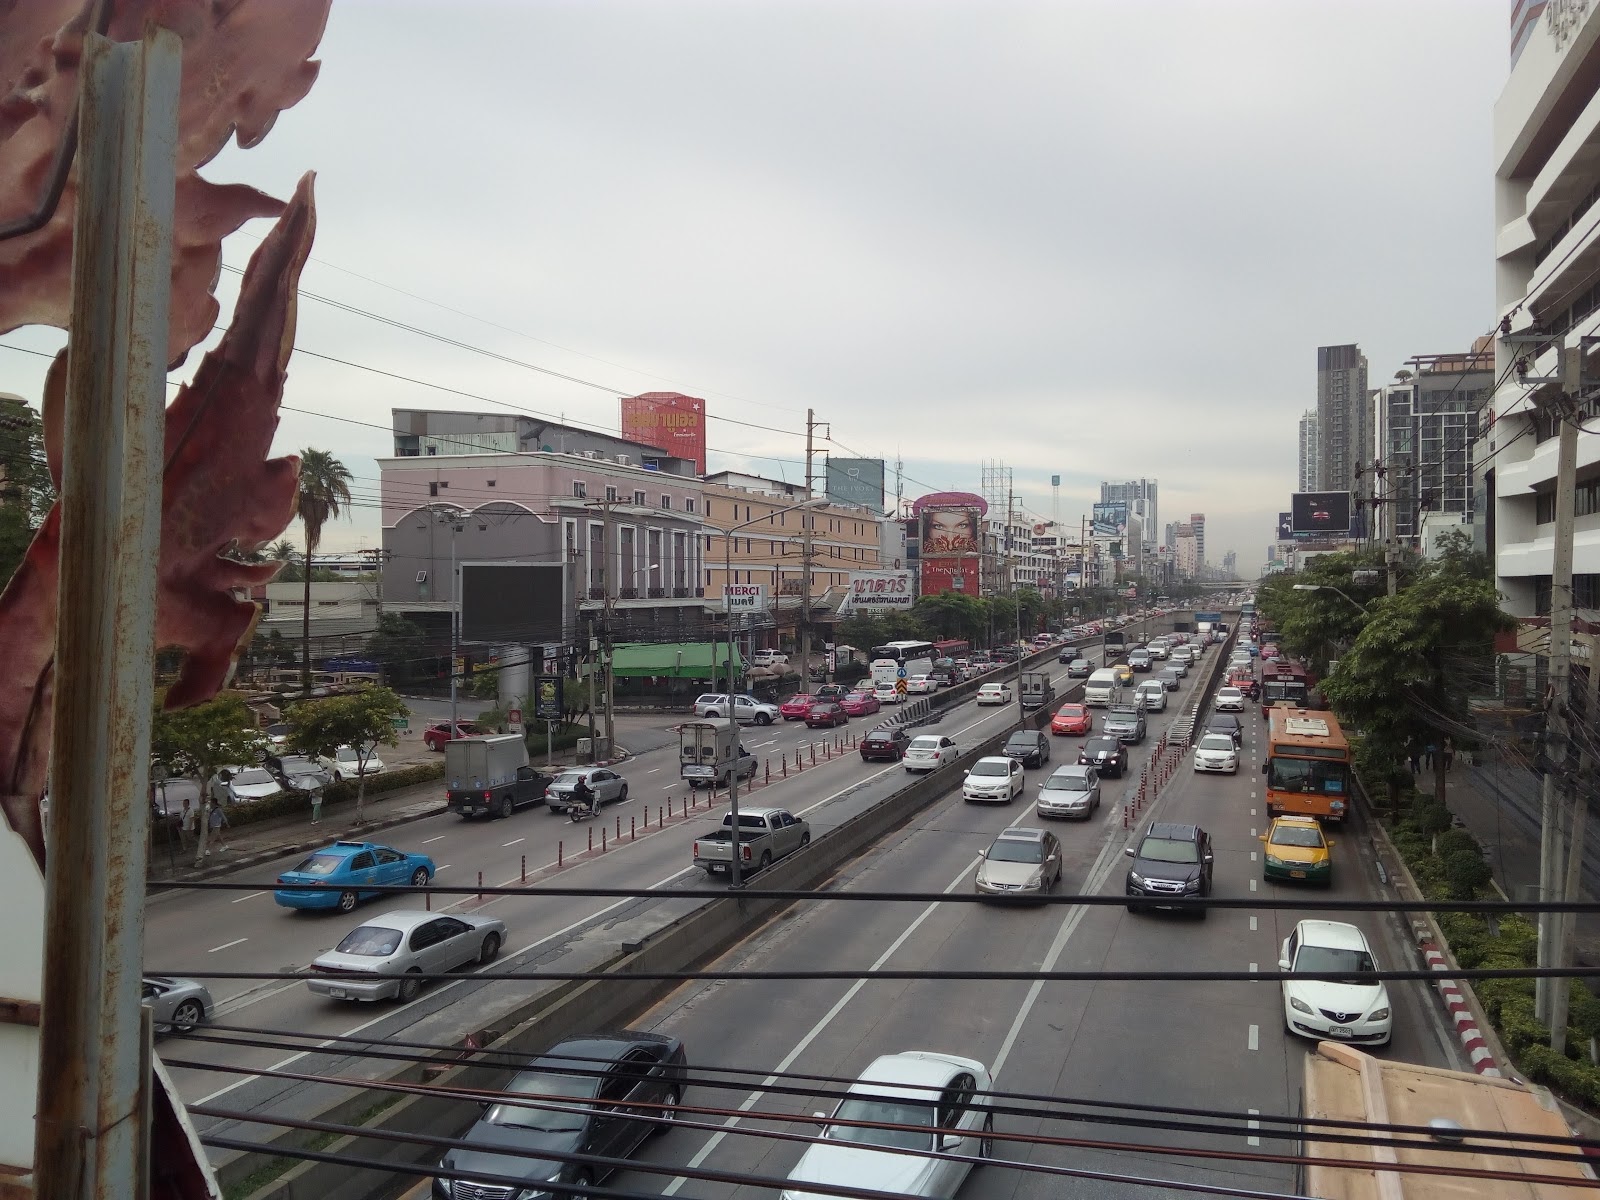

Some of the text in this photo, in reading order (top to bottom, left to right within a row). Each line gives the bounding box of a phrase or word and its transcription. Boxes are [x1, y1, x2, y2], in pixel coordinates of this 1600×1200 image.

[724, 586, 760, 596] MERCI
[853, 574, 908, 594] นาตารี
